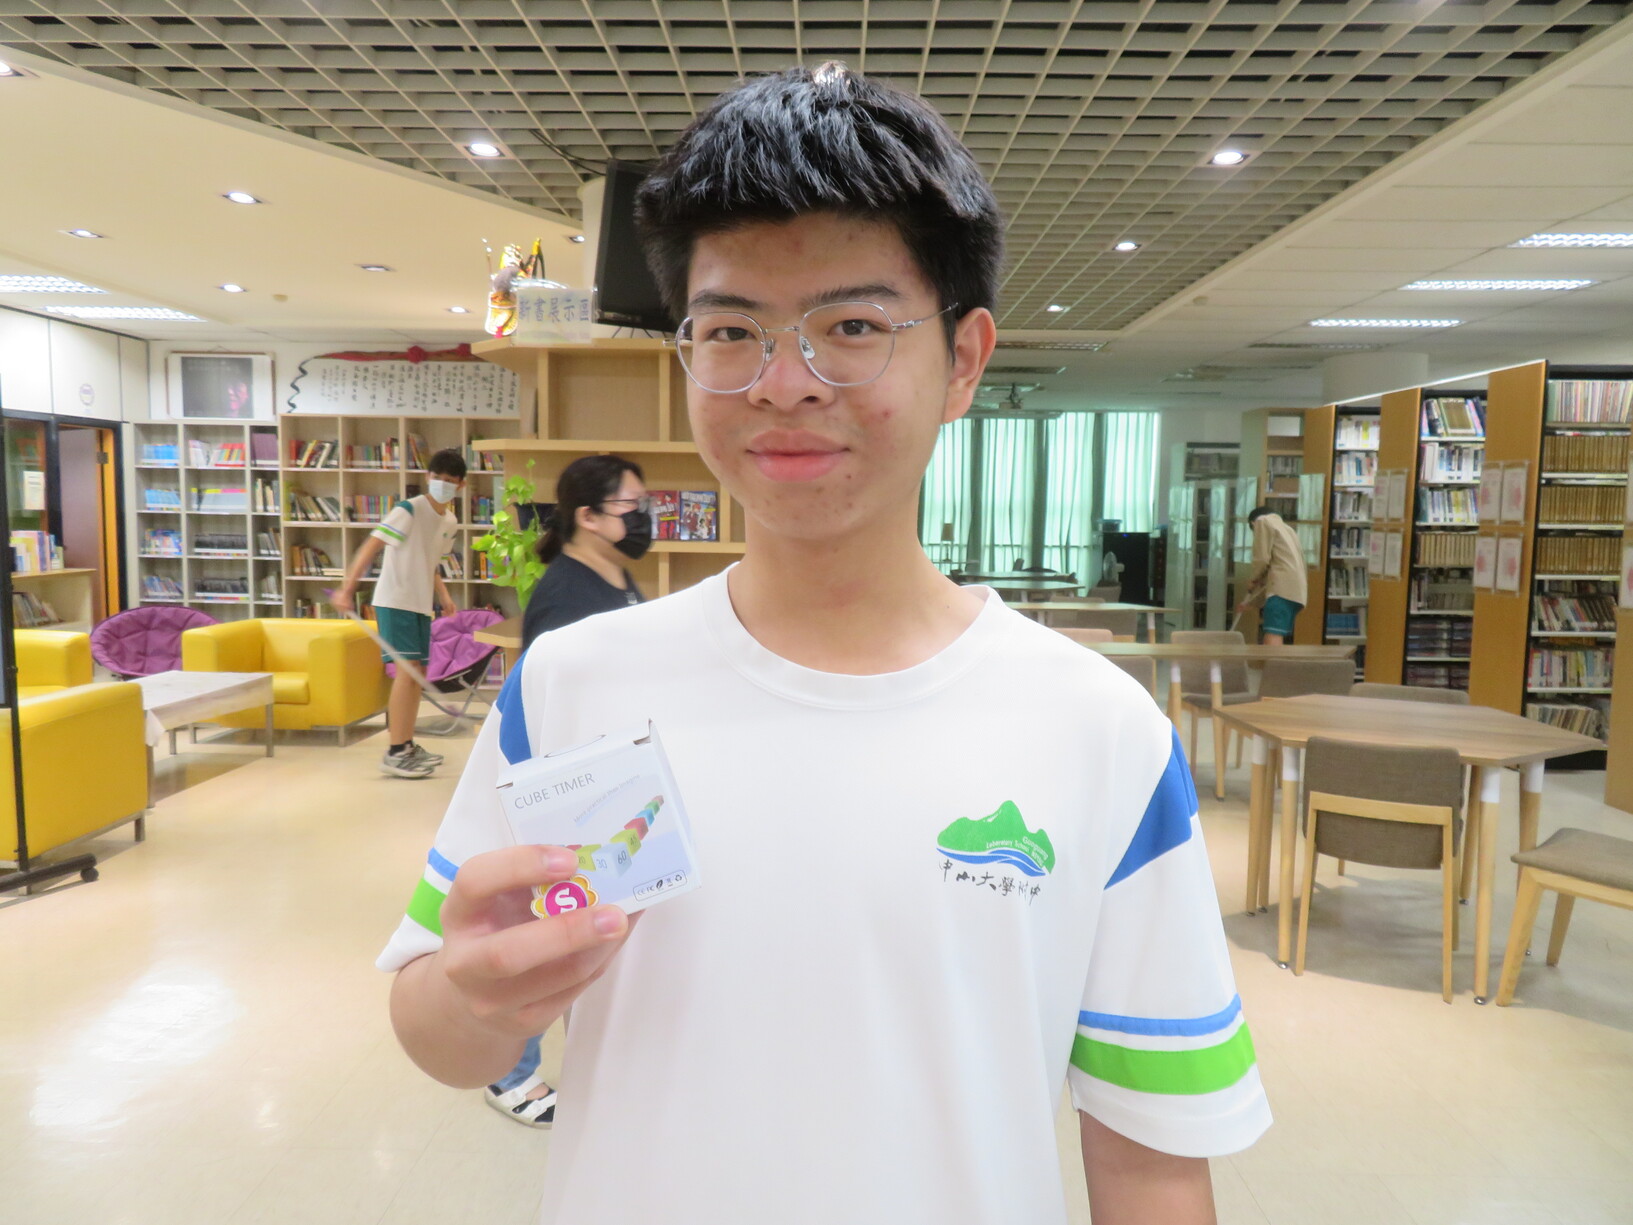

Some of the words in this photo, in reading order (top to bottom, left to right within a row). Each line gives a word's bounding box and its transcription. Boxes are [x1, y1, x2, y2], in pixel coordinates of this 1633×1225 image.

[514, 788, 550, 809] CUBE
[552, 773, 595, 796] TIMER
[596, 858, 608, 869] 30
[617, 850, 627, 865] 60
[554, 887, 578, 914] S
